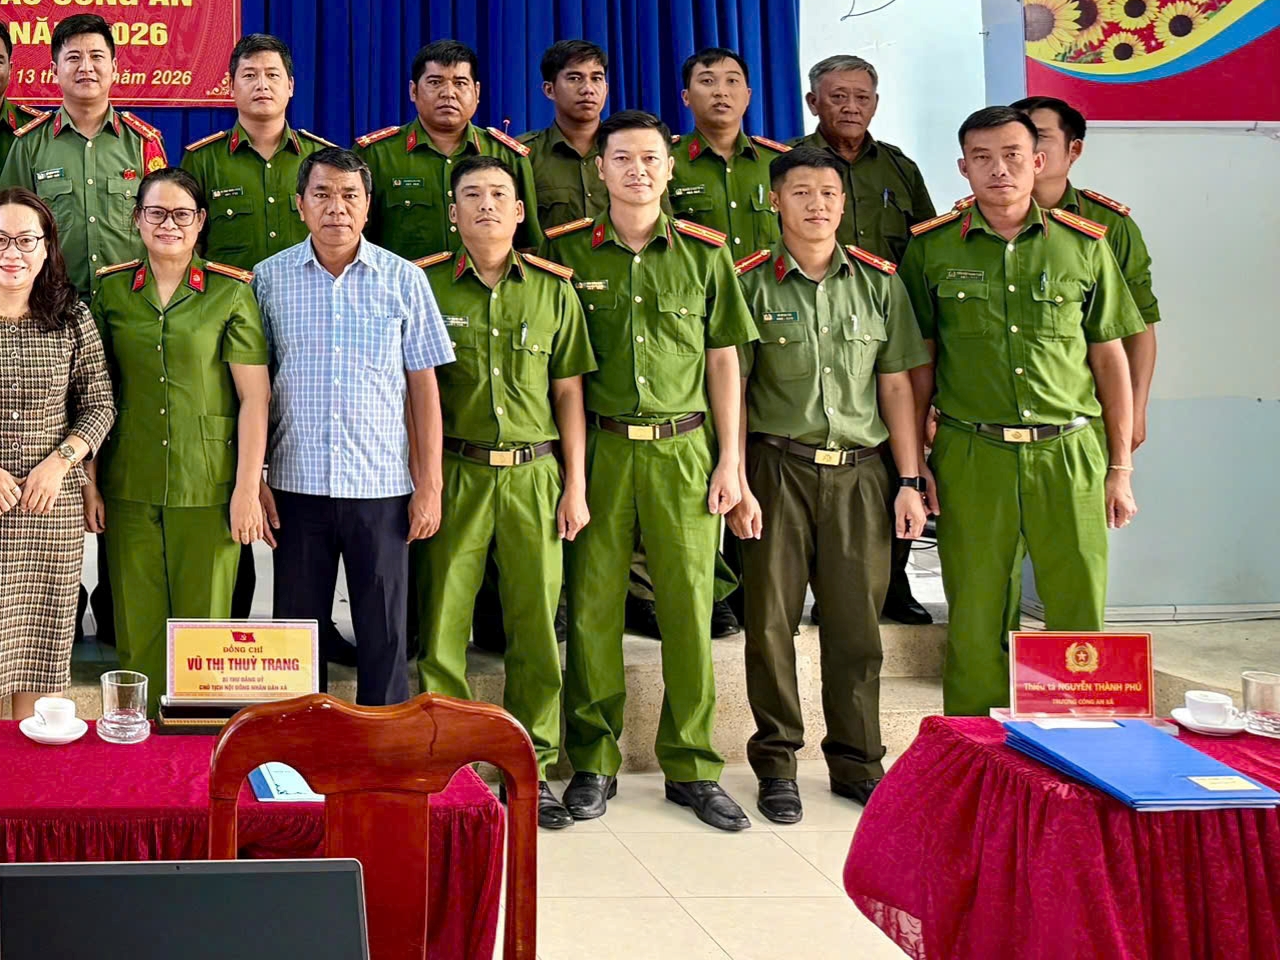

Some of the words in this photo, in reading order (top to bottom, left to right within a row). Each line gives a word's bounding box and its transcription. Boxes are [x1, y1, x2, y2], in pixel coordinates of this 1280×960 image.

[9, 16, 58, 45] NĂ
[112, 22, 168, 46] 026
[17, 69, 35, 84] 13
[152, 70, 192, 85] 2026
[223, 644, 246, 653] ĐỒNG
[187, 655, 202, 671] VŨ
[206, 657, 224, 673] THỊ
[261, 657, 299, 671] TRANG
